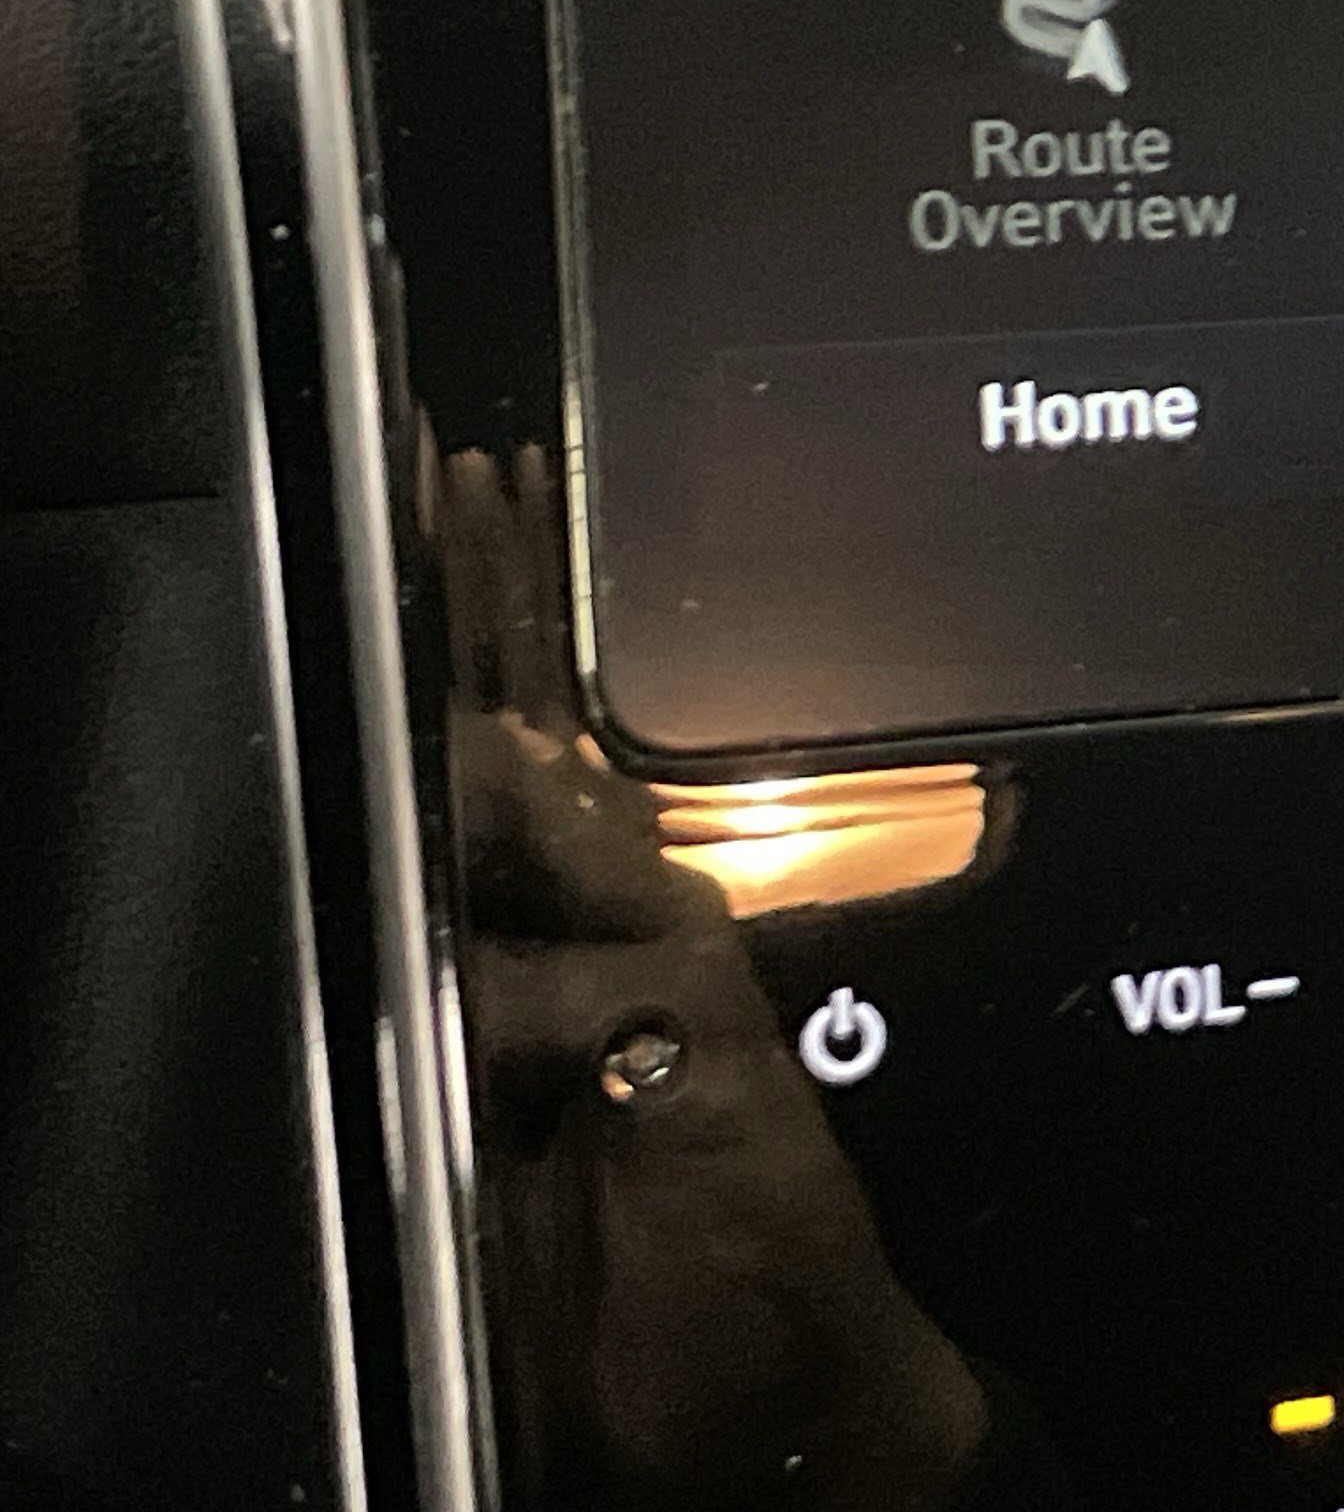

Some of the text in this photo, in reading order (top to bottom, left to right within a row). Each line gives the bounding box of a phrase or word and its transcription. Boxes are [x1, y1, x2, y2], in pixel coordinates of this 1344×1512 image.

[971, 118, 1171, 180] Route
[909, 180, 1237, 252] Overview
[979, 379, 1199, 450] Home
